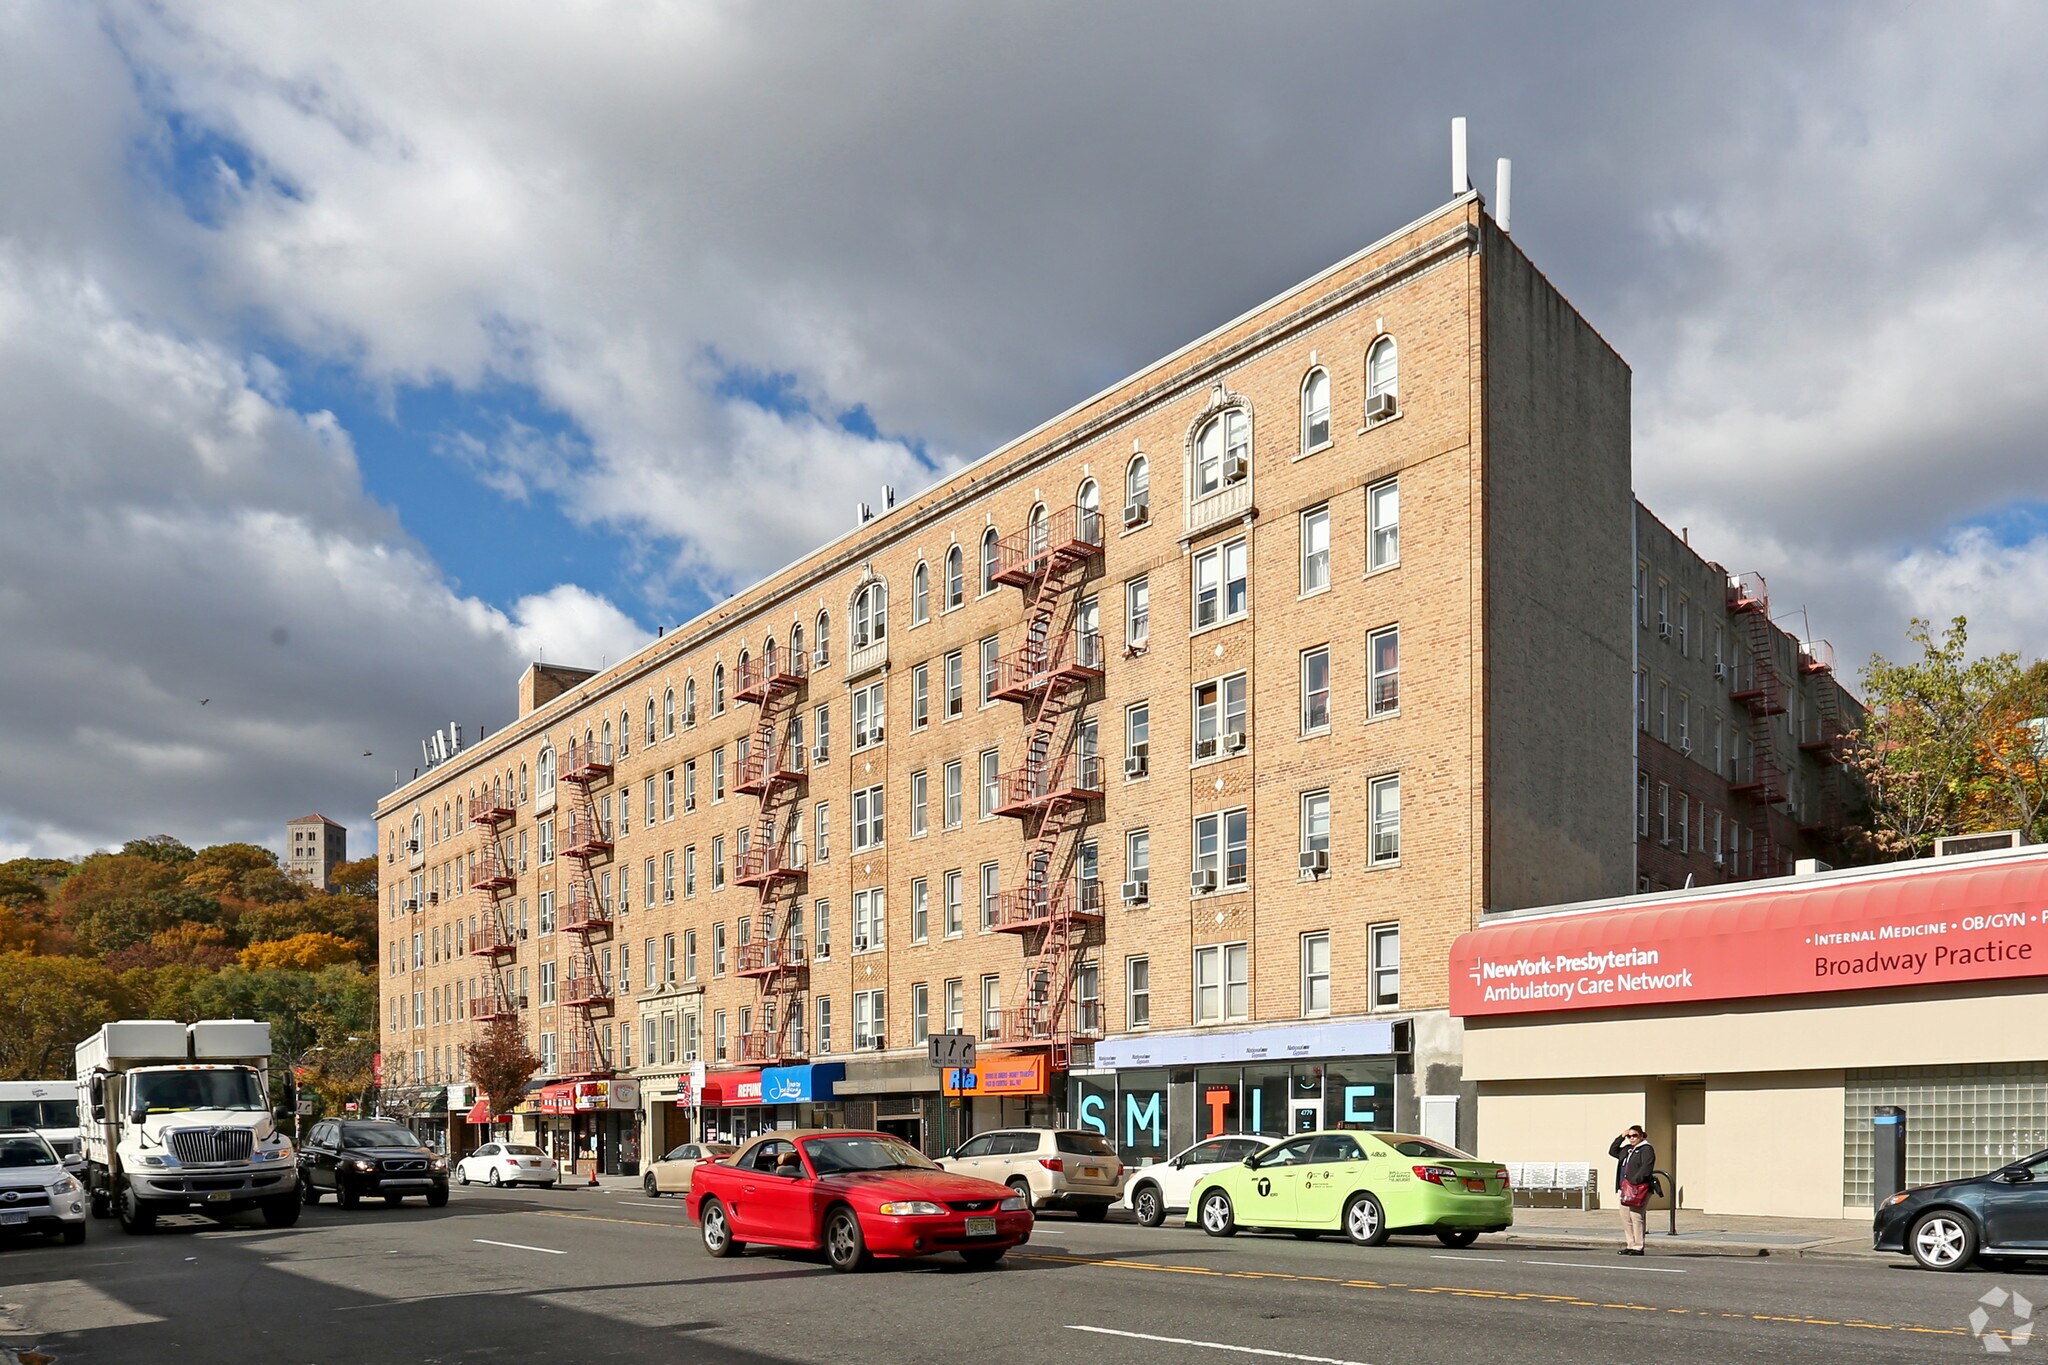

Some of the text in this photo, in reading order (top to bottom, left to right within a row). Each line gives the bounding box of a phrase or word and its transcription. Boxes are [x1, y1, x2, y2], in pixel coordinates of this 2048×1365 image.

[1962, 912, 2026, 932] OB/GYN
[1483, 948, 1659, 980] NewYork-Presbyterian
[1815, 940, 2033, 977] Broadway Practice
[1484, 968, 1693, 1003] Ambulatory Care Network
[949, 1068, 978, 1089] Ria
